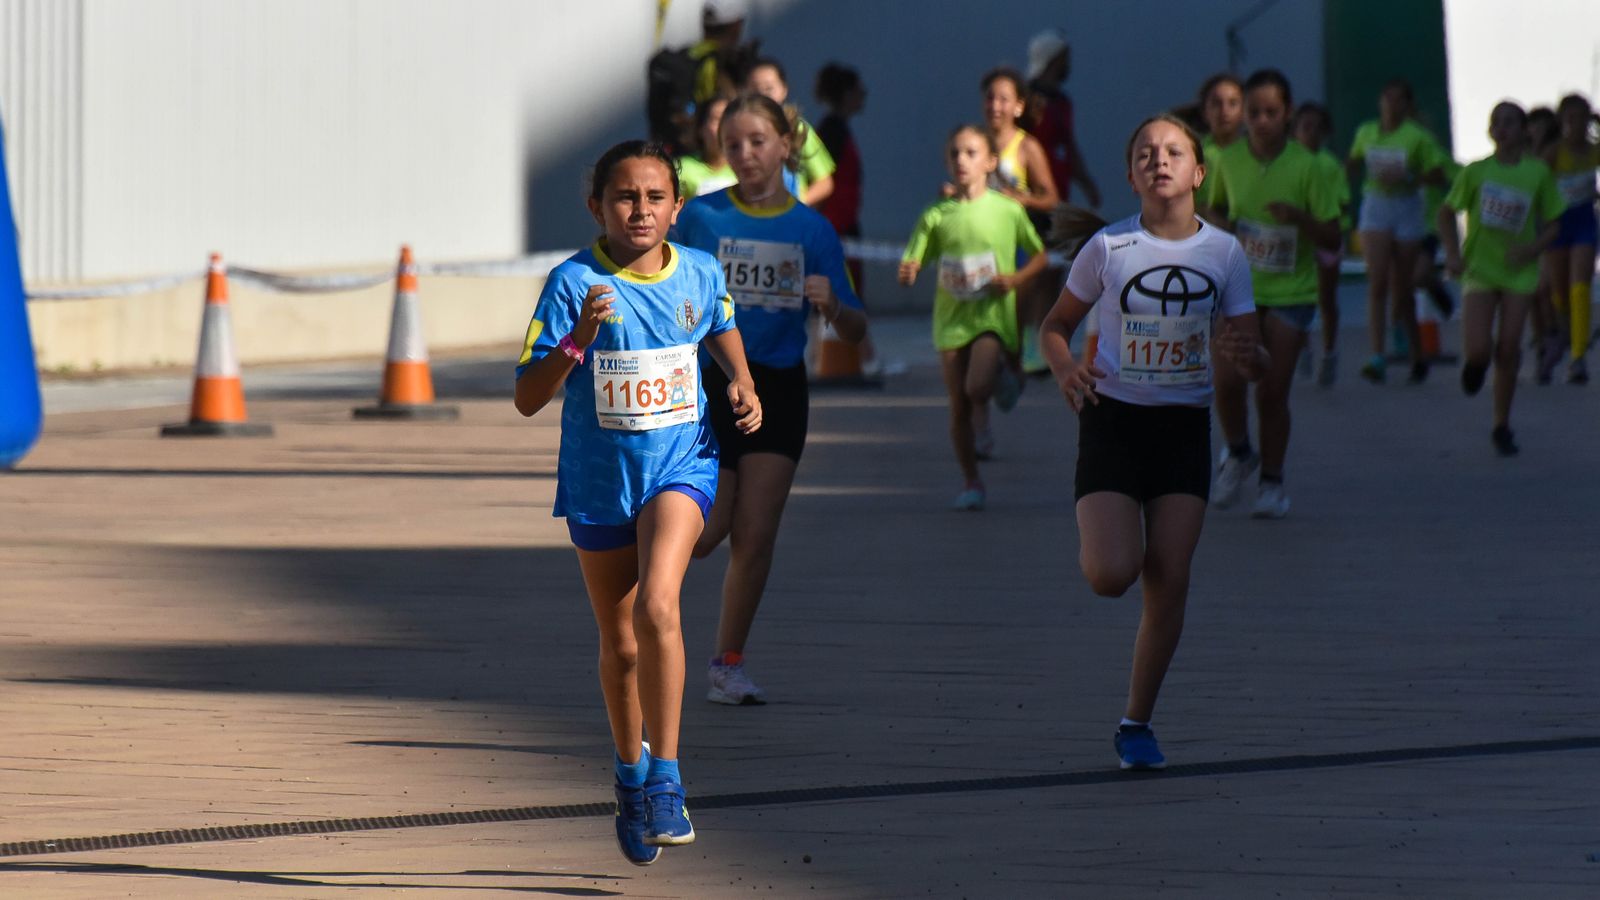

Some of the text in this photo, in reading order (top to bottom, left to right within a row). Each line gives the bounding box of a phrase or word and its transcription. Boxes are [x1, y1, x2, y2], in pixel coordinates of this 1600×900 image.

[723, 262, 775, 288] 1513
[1126, 320, 1141, 332] XXI
[599, 358, 617, 371] XXI
[1127, 340, 1185, 367] 1175
[603, 378, 667, 408] 1163
